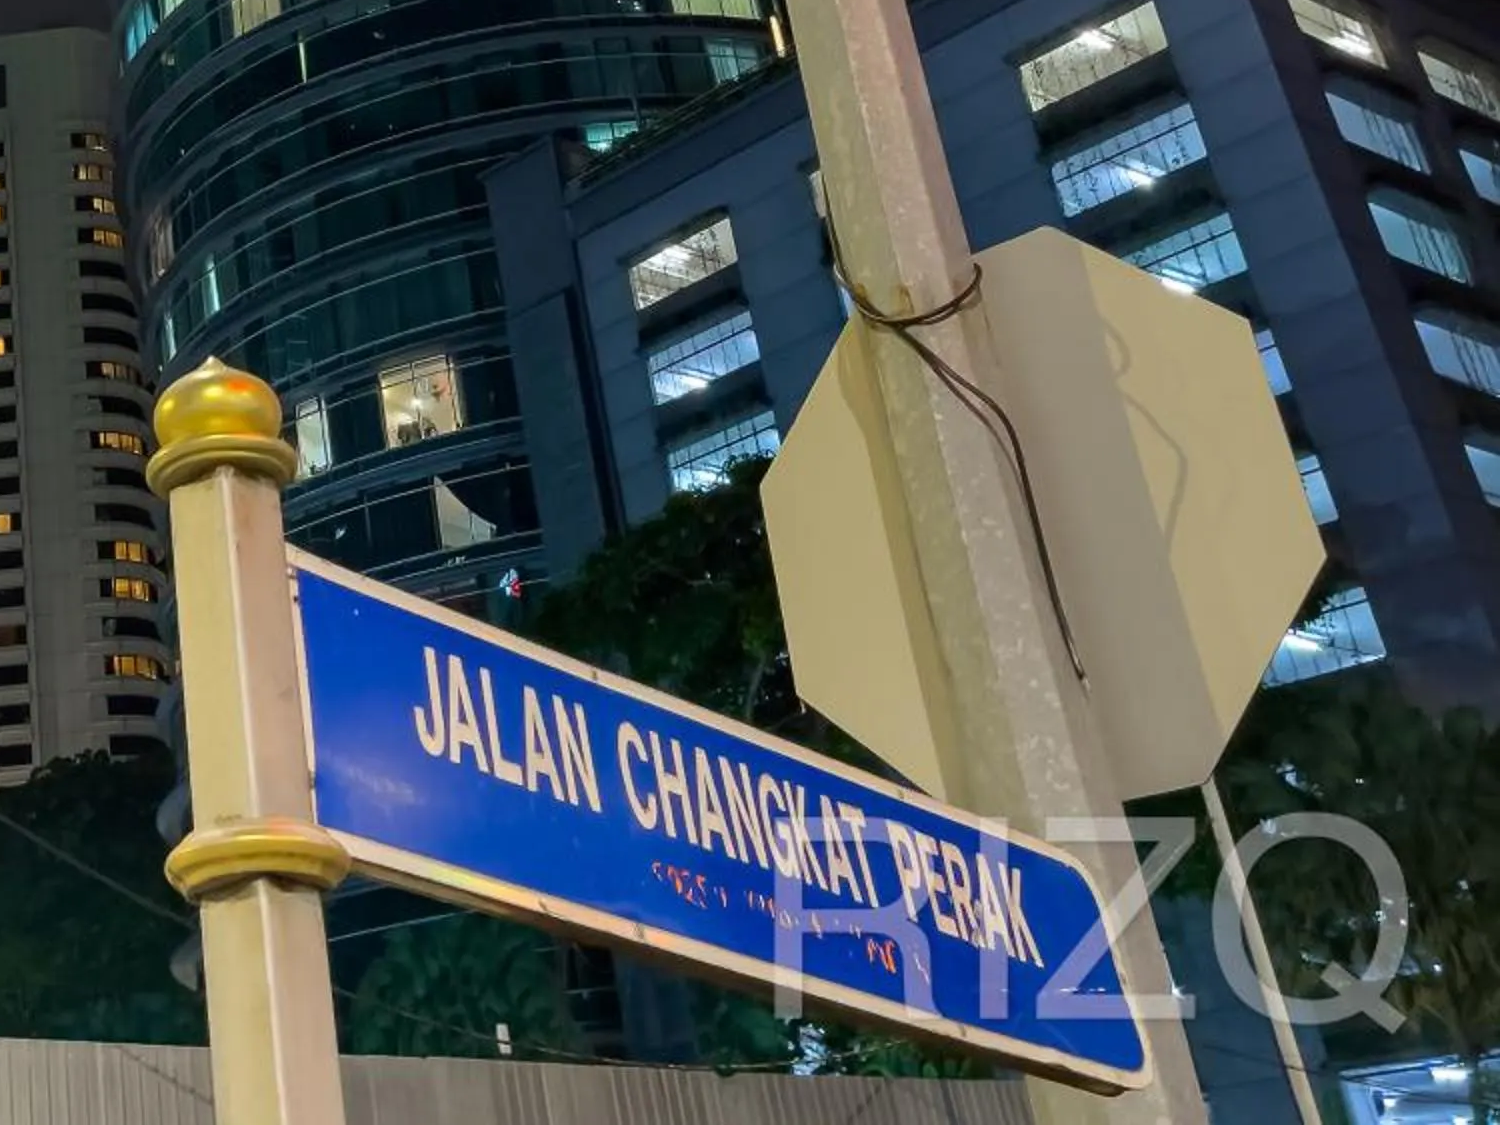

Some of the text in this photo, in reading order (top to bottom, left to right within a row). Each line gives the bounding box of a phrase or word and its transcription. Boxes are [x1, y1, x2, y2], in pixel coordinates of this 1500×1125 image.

[413, 645, 602, 813] JALAN
[616, 720, 880, 909] CHANGKAT
[885, 818, 1045, 969] PERAK
